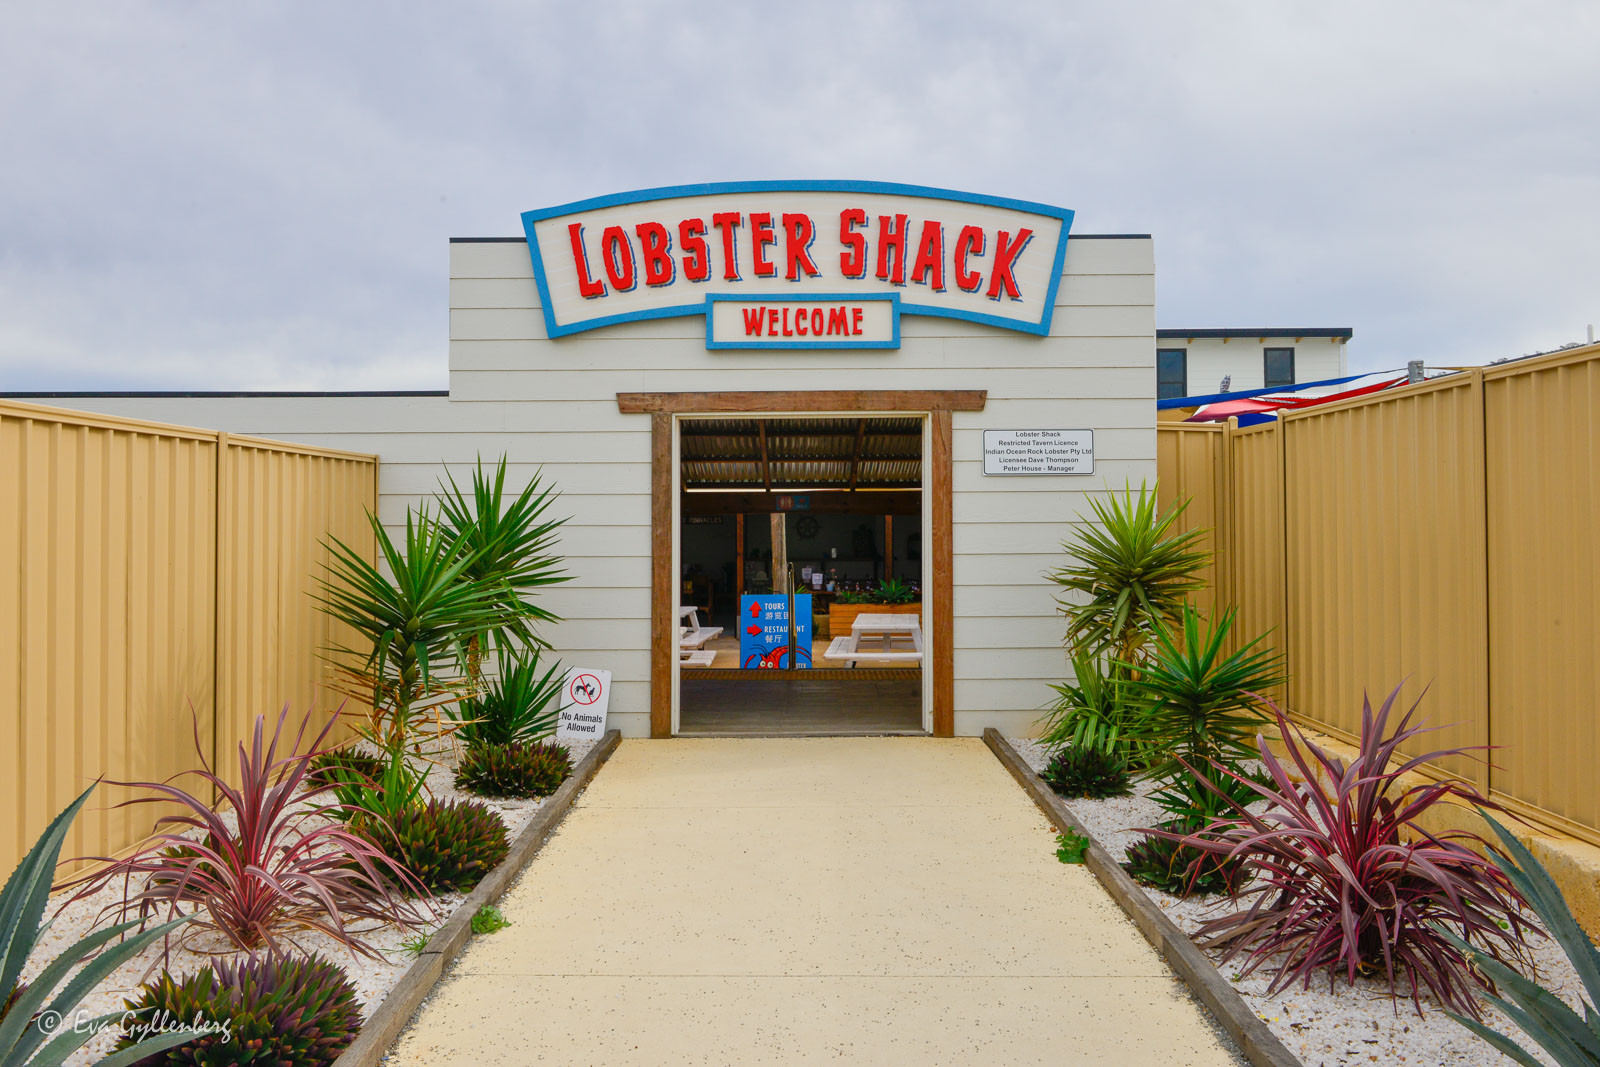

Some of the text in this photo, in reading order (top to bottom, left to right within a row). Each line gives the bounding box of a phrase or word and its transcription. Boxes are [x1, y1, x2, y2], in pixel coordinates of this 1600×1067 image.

[568, 208, 1034, 302] LOBSTER SHACK
[742, 306, 864, 336] WELCOME
[764, 625, 805, 633] RESTAUNT
[562, 712, 602, 723] No Animals
[567, 723, 596, 732] Allowed
